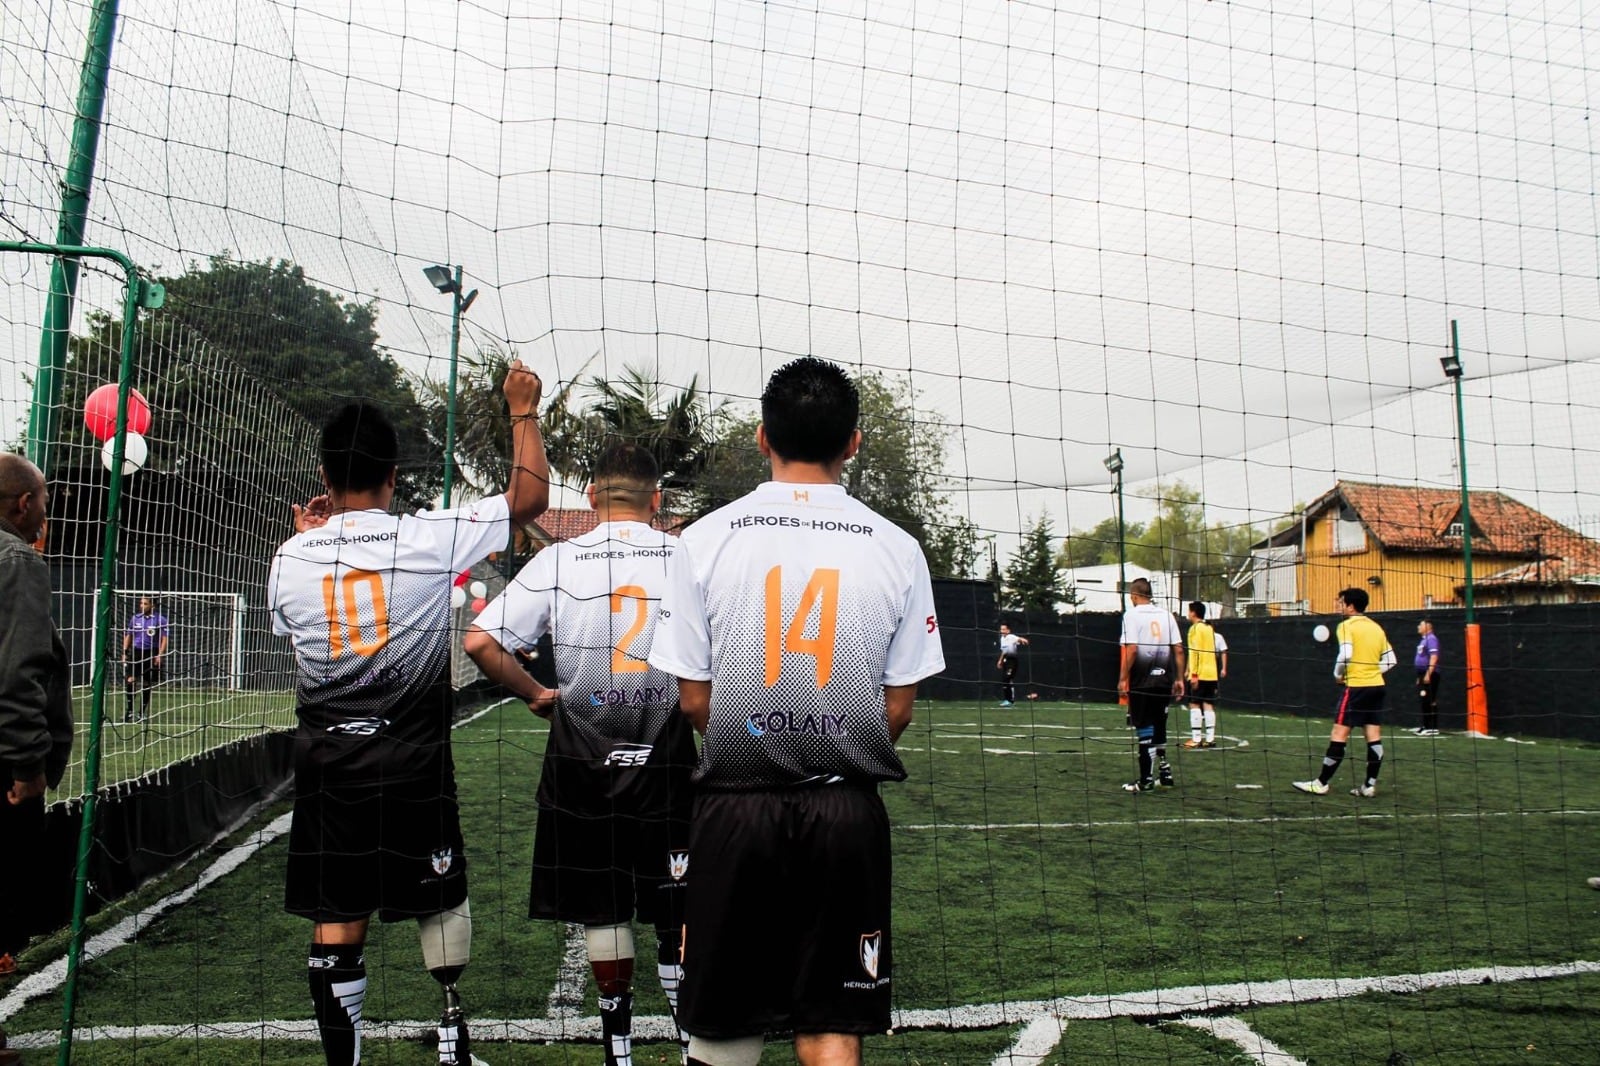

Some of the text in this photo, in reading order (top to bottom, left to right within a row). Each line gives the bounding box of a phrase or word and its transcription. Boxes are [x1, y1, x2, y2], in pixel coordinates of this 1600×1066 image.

[812, 519, 873, 537] HONOR
[322, 569, 389, 660] 10
[611, 584, 649, 673] 2
[764, 565, 840, 689] 14
